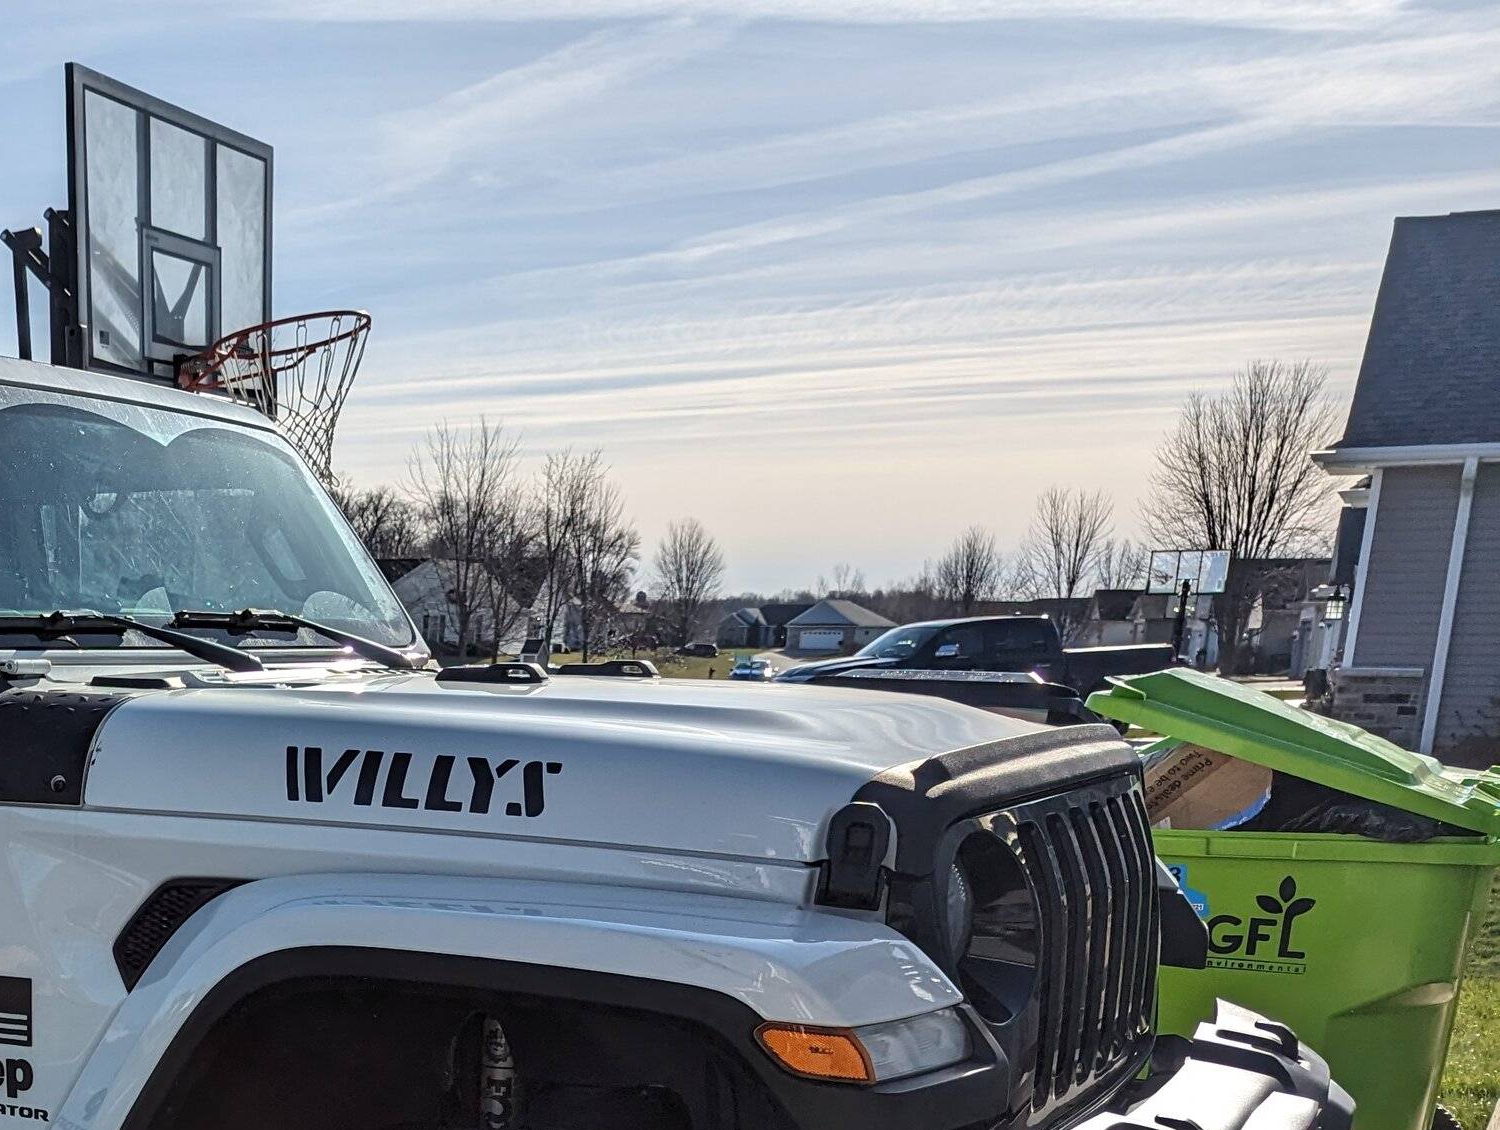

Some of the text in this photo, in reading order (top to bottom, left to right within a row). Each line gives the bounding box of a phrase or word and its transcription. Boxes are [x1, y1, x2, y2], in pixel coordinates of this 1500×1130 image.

[1179, 749, 1204, 767] Two
[1168, 763, 1181, 776] to
[1181, 757, 1213, 781] Prime
[286, 746, 563, 817] WILLYS
[1153, 773, 1171, 787] be
[1208, 910, 1308, 959] GFL
[1207, 959, 1307, 974] nvironmental
